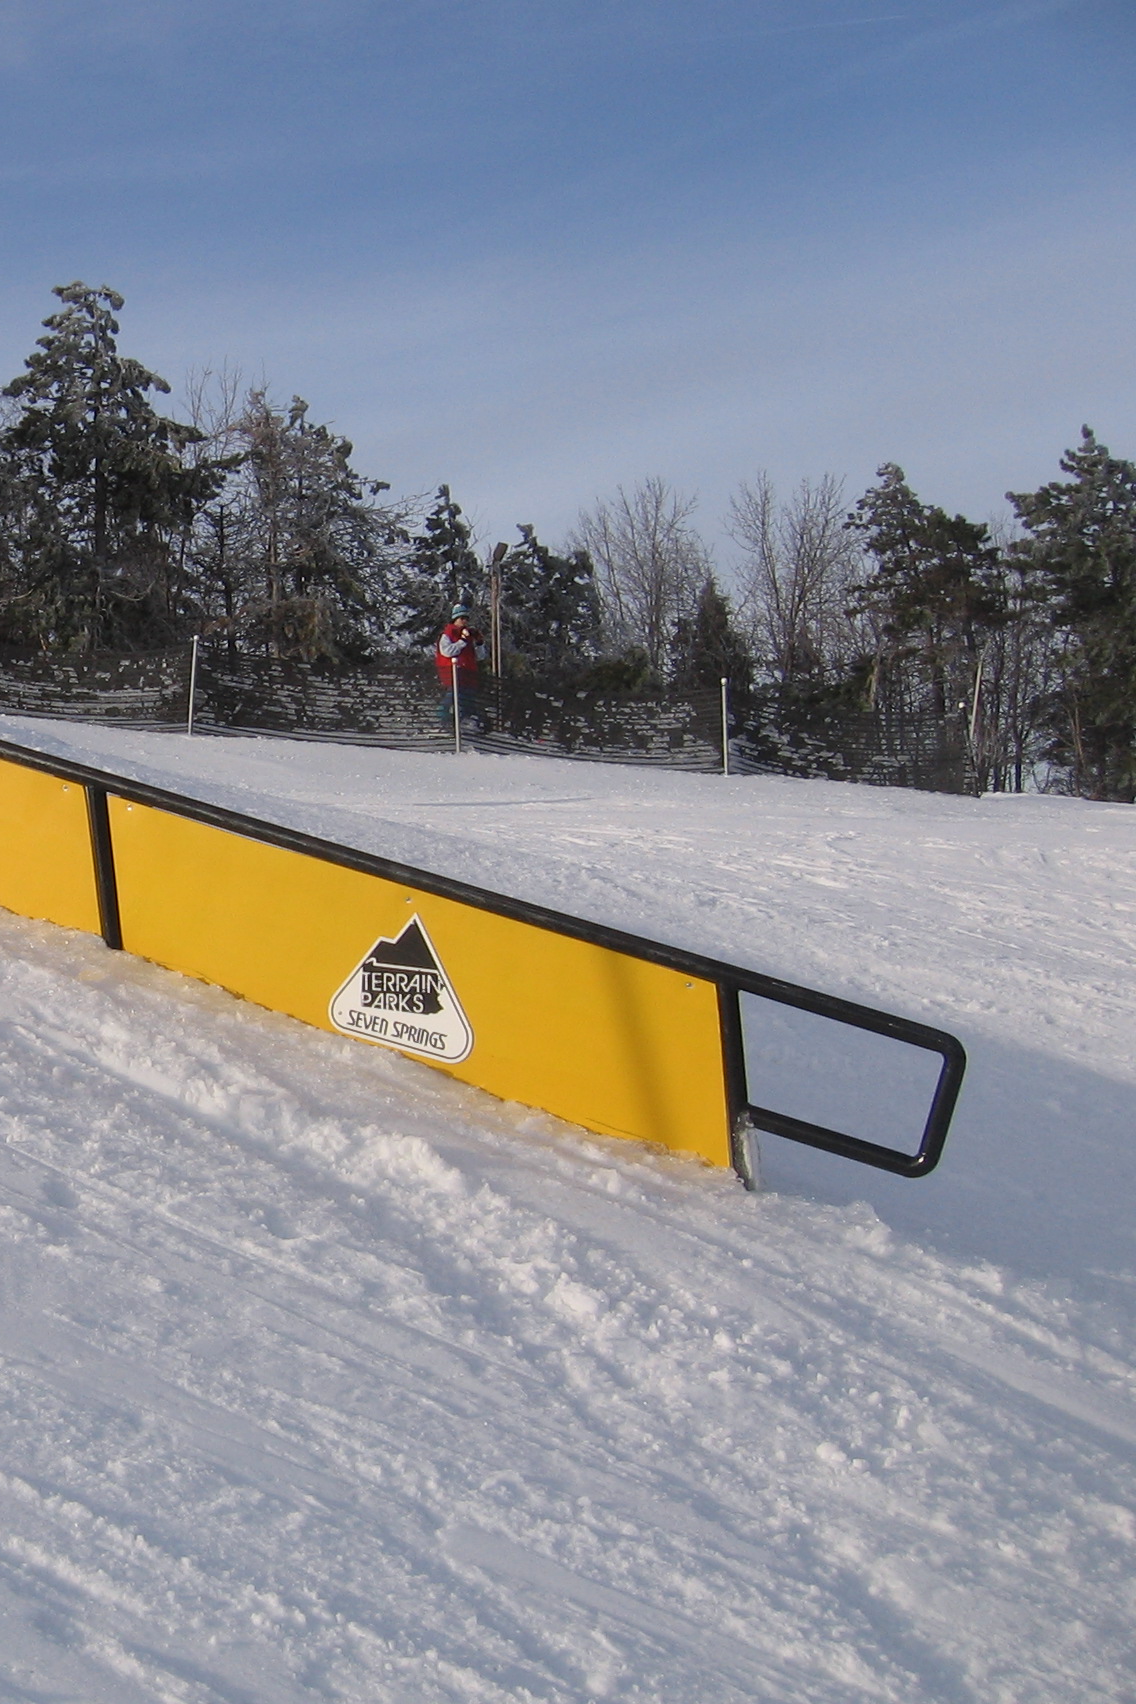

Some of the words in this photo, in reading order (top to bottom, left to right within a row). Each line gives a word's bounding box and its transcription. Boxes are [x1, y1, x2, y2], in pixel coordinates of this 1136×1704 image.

[362, 993, 424, 1013] PARKS
[347, 1009, 389, 1035] SEVEN
[391, 1021, 447, 1050] SPRINGS
